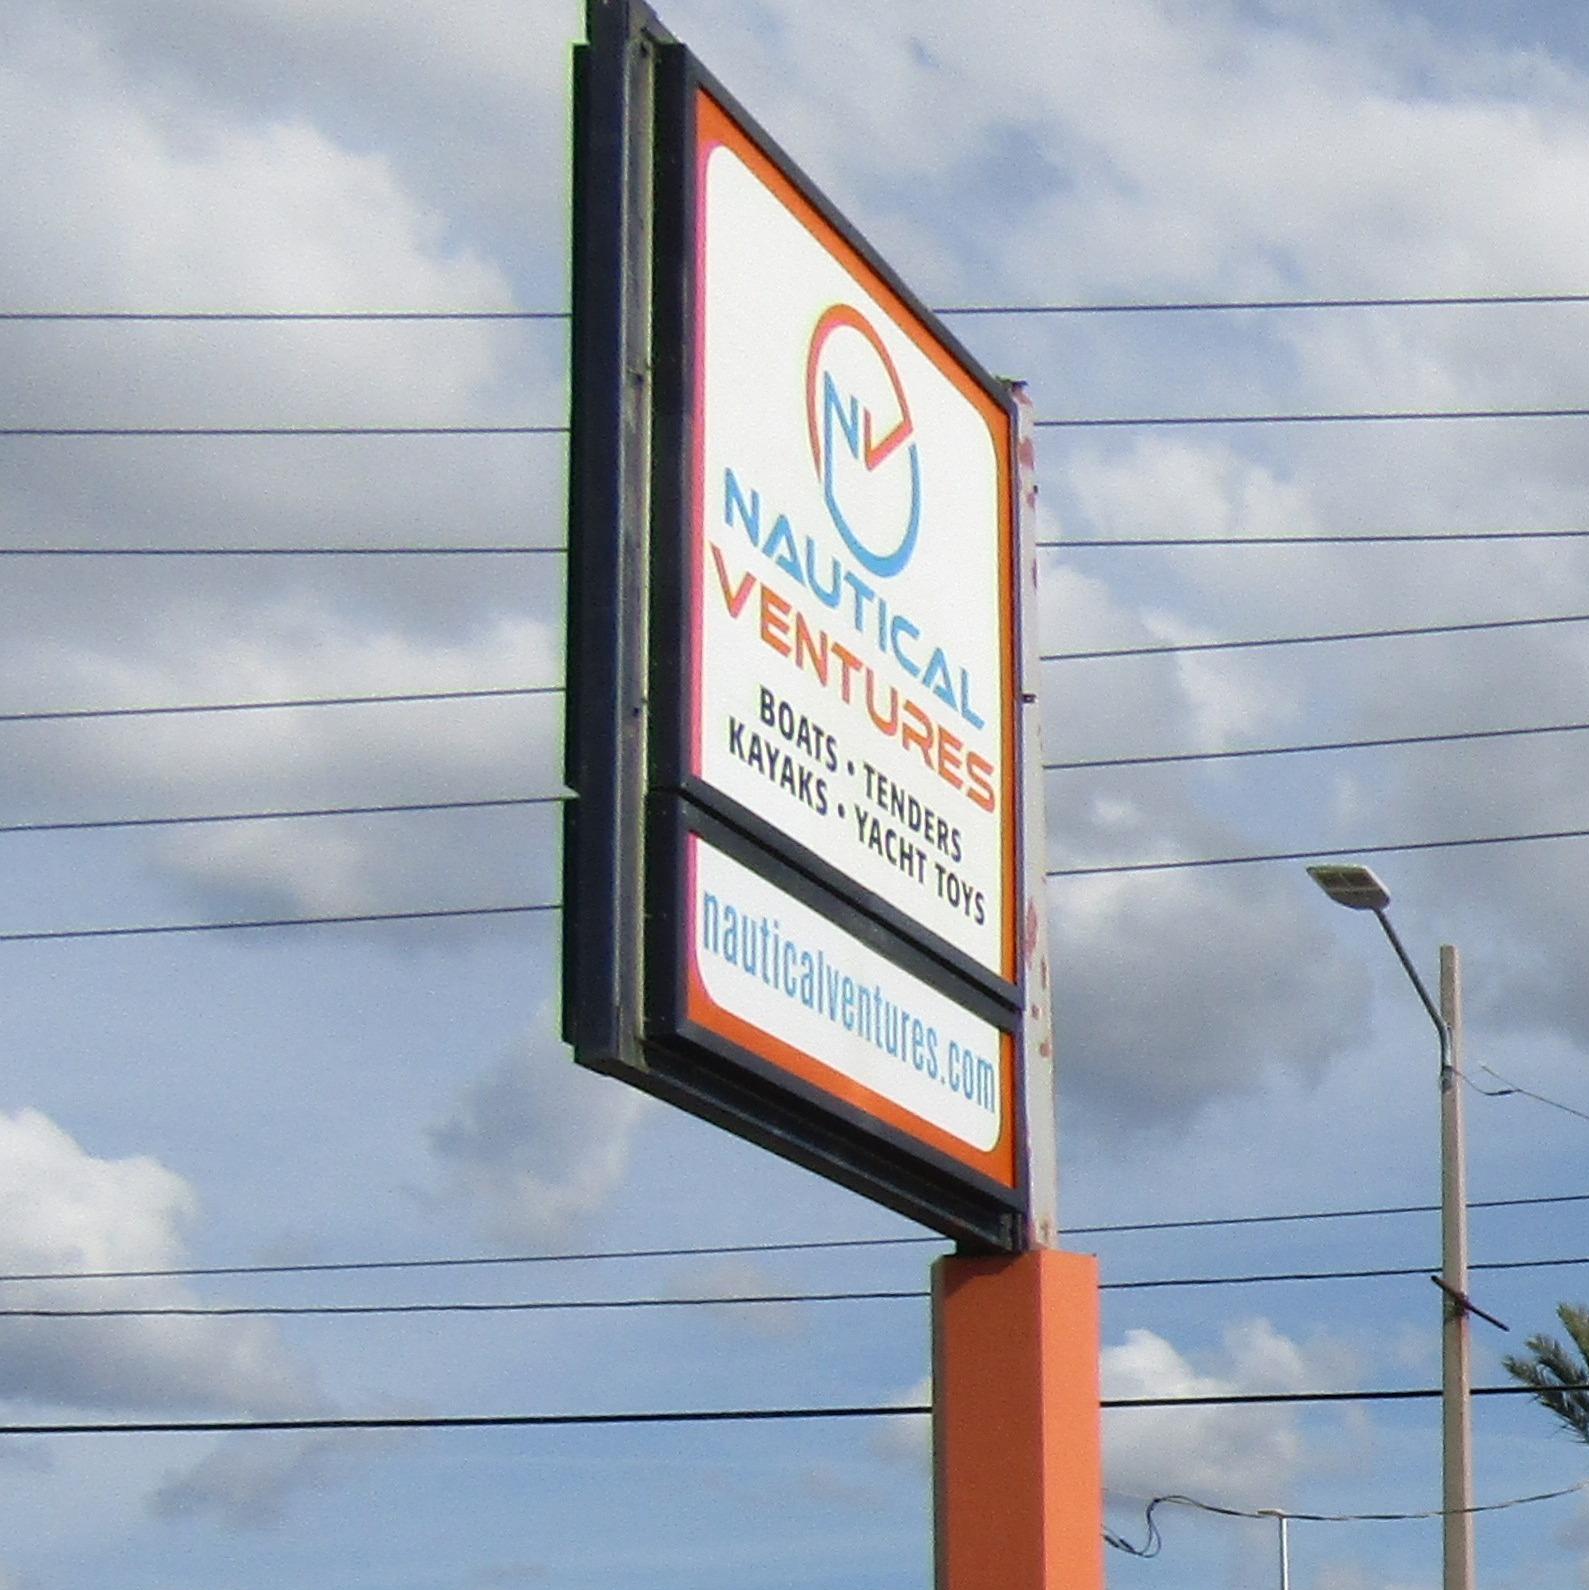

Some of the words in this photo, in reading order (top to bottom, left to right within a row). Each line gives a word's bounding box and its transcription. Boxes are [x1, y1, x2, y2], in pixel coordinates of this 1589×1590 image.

[710, 540, 996, 814] VENTURES
[724, 466, 984, 730] NAUTICAL
[728, 715, 828, 816] KAYAKS
[854, 804, 928, 887] YACHT
[934, 862, 987, 928] TOYS
[759, 684, 838, 772] BOATS
[863, 760, 962, 863] TENDERS
[702, 890, 996, 1115] nauticalventures.com
